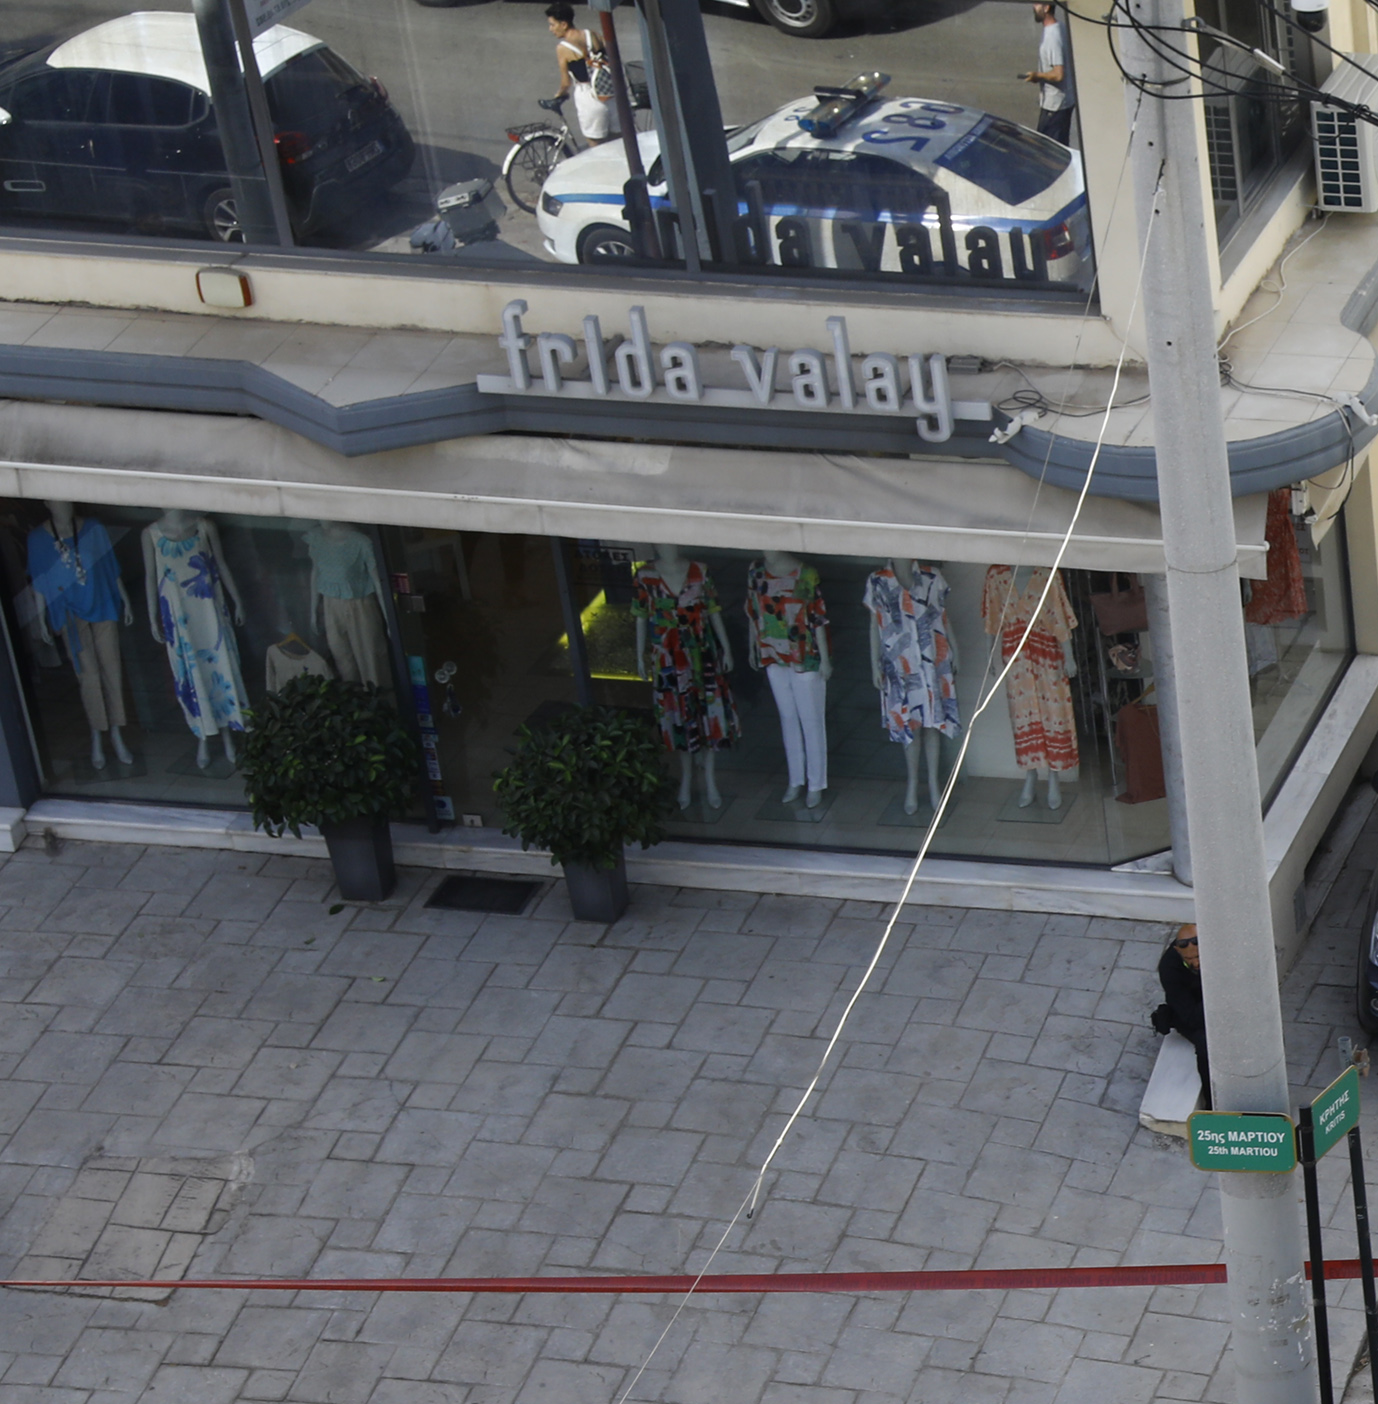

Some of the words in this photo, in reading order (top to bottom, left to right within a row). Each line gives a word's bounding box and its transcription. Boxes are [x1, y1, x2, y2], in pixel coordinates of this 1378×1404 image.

[500, 299, 704, 400] frida
[731, 316, 955, 443] valay
[1319, 1090, 1350, 1126] ΚΡΗΤΗΣ
[1325, 1111, 1346, 1134] KRITIS
[1197, 1130, 1225, 1144] 25ης
[1228, 1131, 1286, 1144] ΜΑΡΤΙΟΥ
[1208, 1146, 1229, 1155] 25th
[1231, 1147, 1278, 1157] MARTIOU
